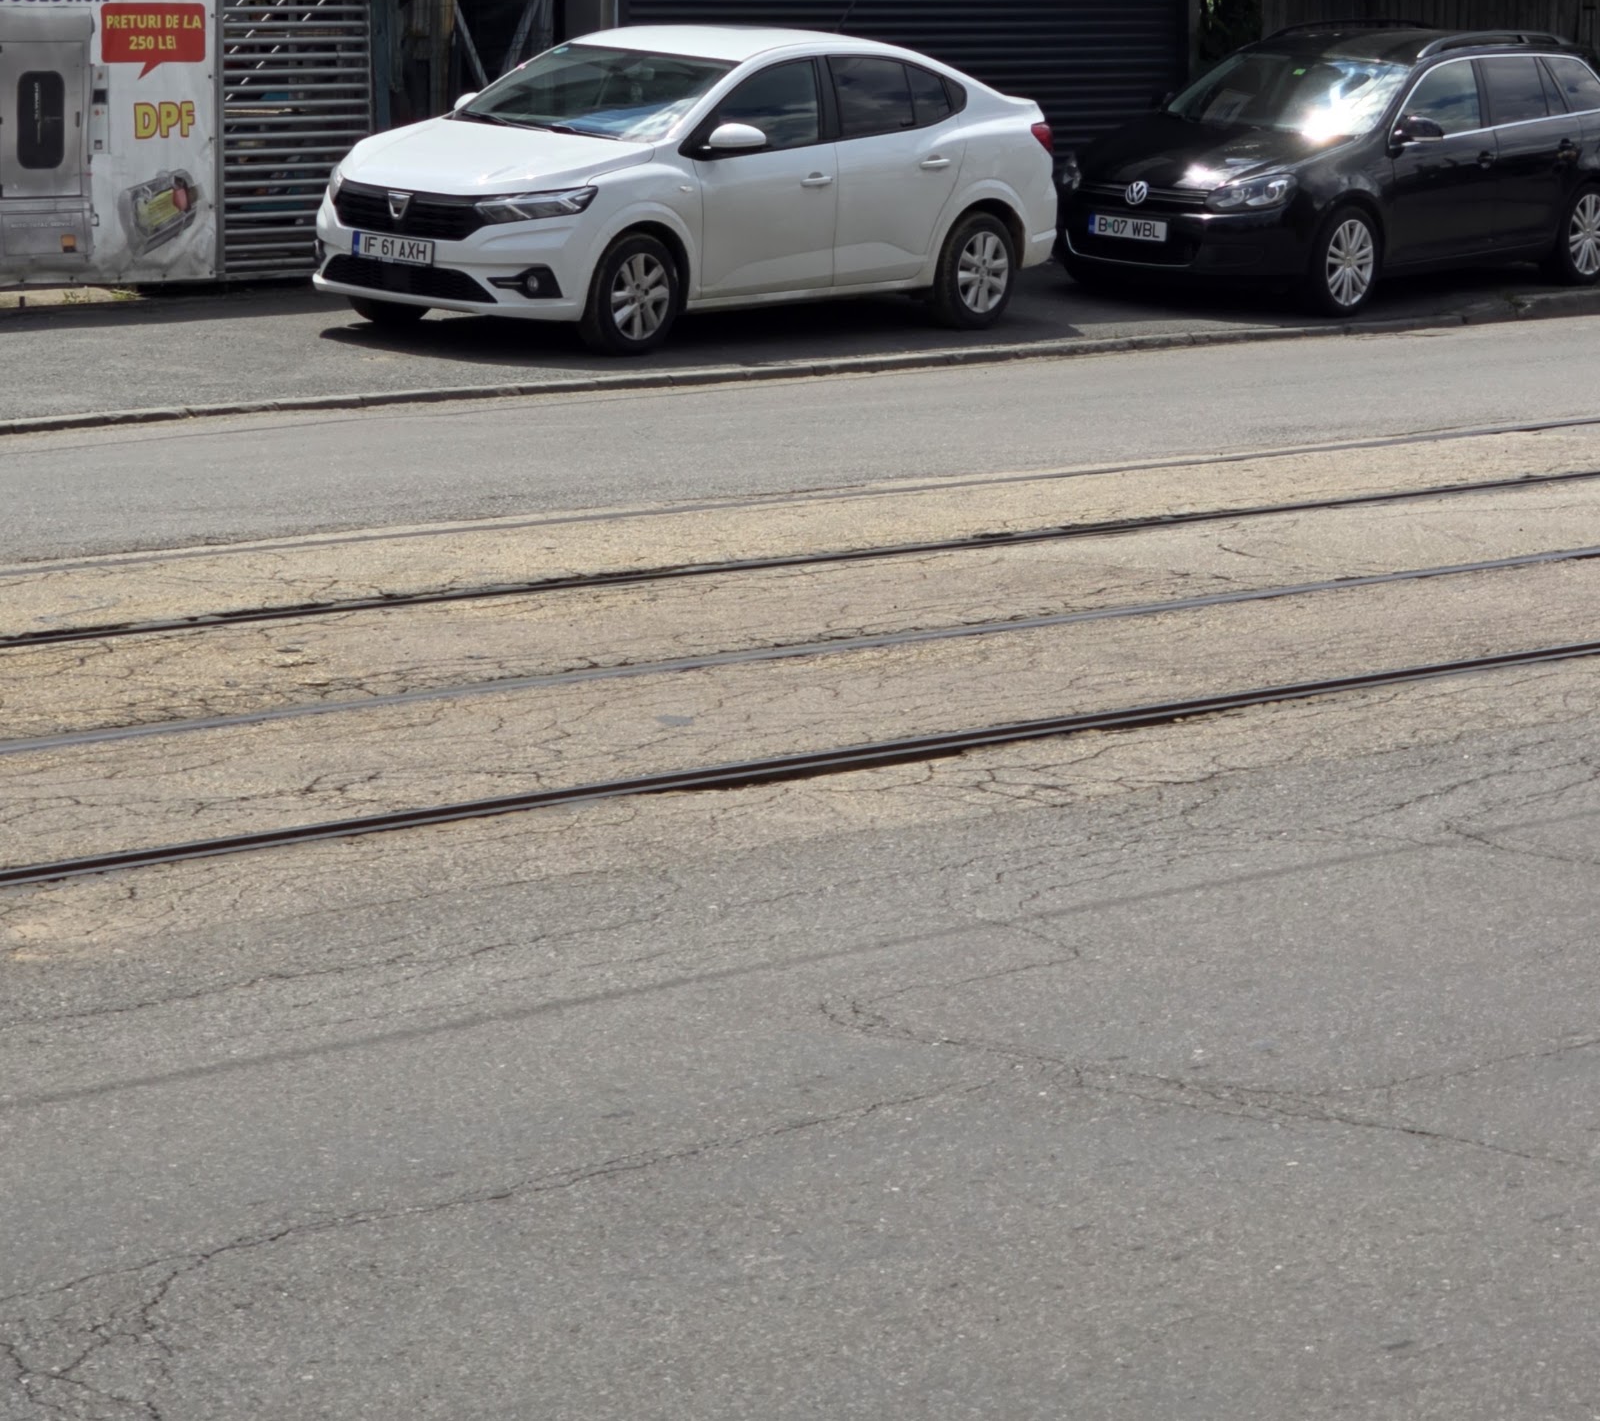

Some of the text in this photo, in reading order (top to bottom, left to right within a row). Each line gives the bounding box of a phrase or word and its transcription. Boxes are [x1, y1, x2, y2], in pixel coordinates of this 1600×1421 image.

[106, 14, 202, 29] PRETURI DE LA
[129, 35, 177, 50] 250 LEI
[133, 100, 196, 140] DPF
[1098, 217, 1160, 238] B 07 WBL
[363, 236, 427, 261] IF 61 AXH
